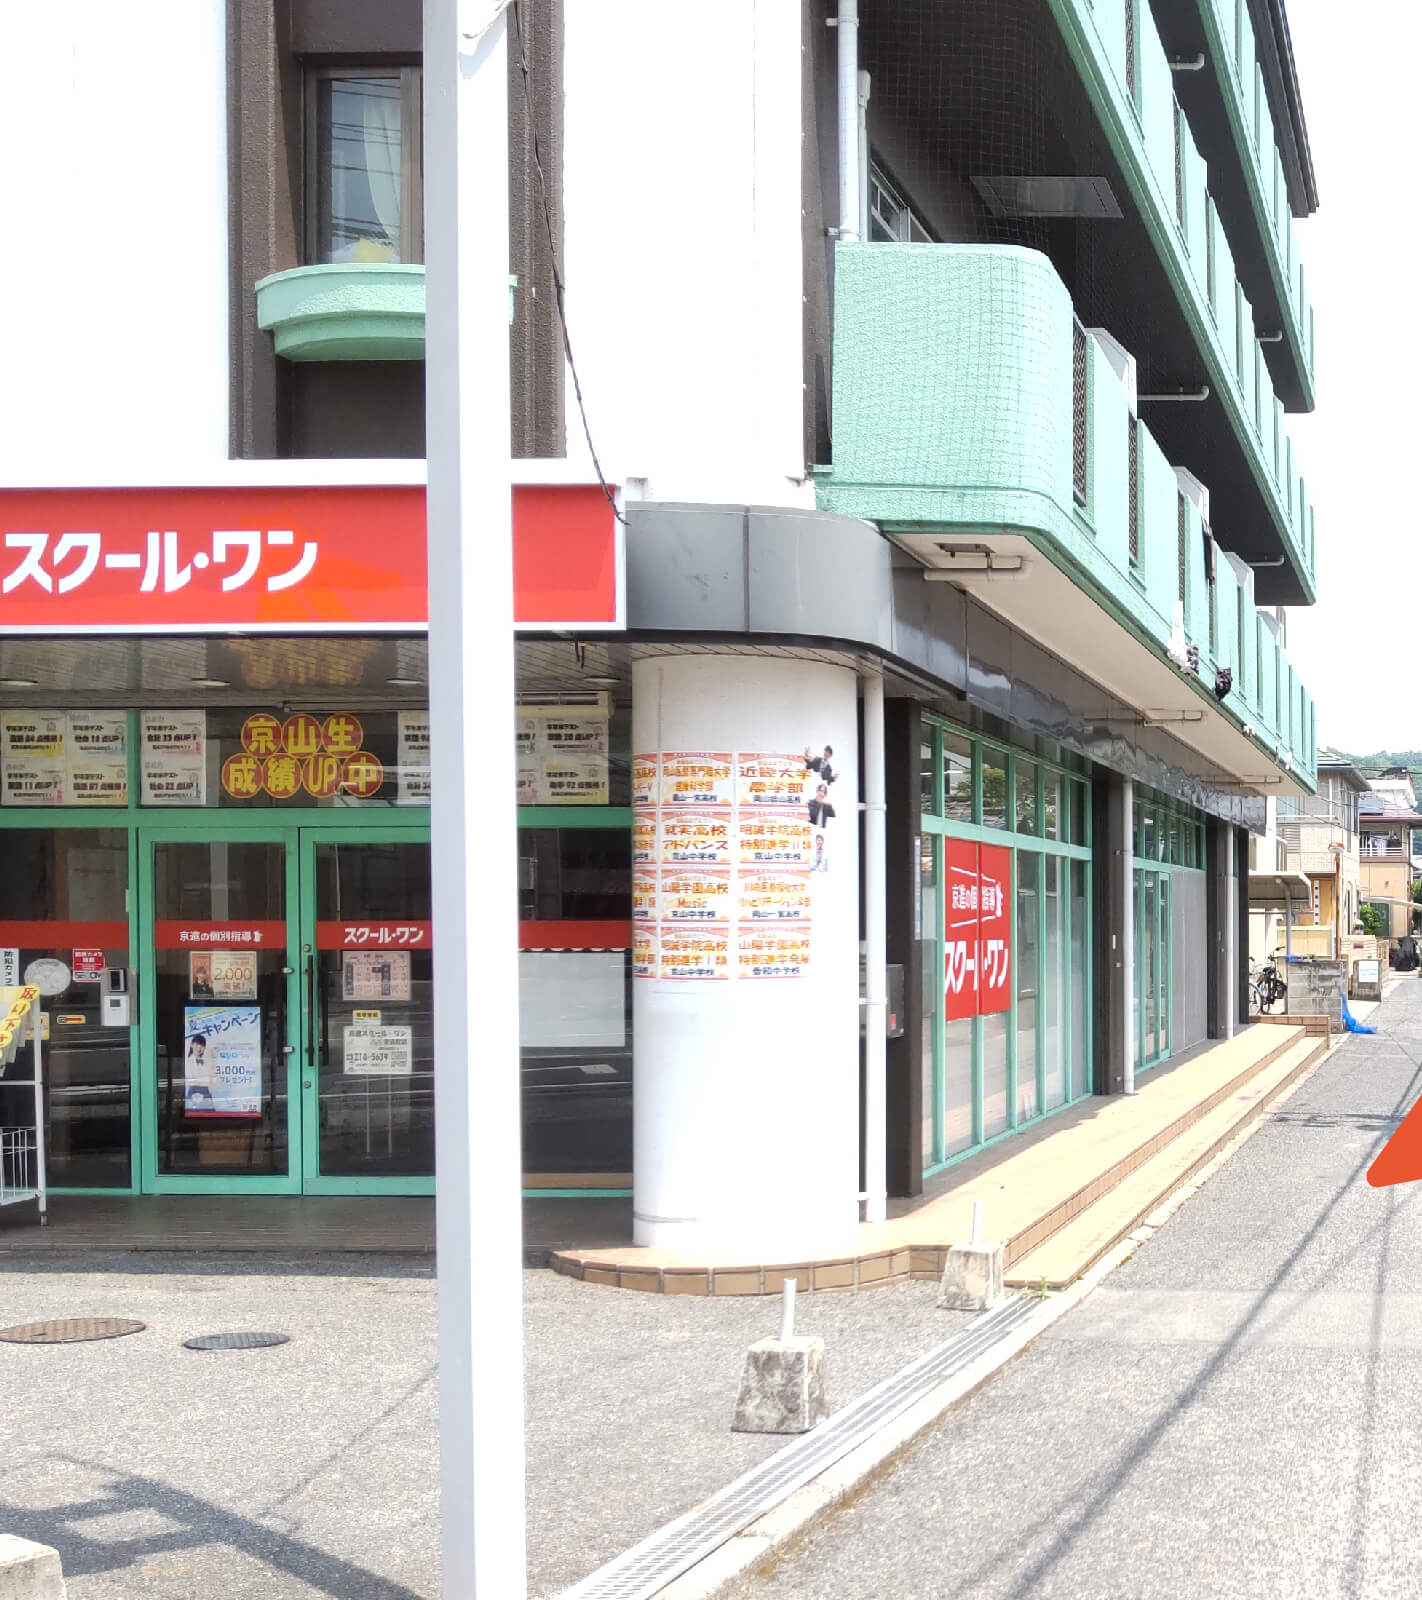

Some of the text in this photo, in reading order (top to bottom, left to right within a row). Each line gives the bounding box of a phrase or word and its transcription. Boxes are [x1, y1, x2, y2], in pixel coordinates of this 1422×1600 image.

[2, 530, 318, 593] スクール・ワン
[247, 717, 357, 754] 京山生
[229, 757, 377, 793] 成績UP中
[344, 927, 424, 944] スクール・ワン
[203, 1012, 261, 1037] キャンペーン
